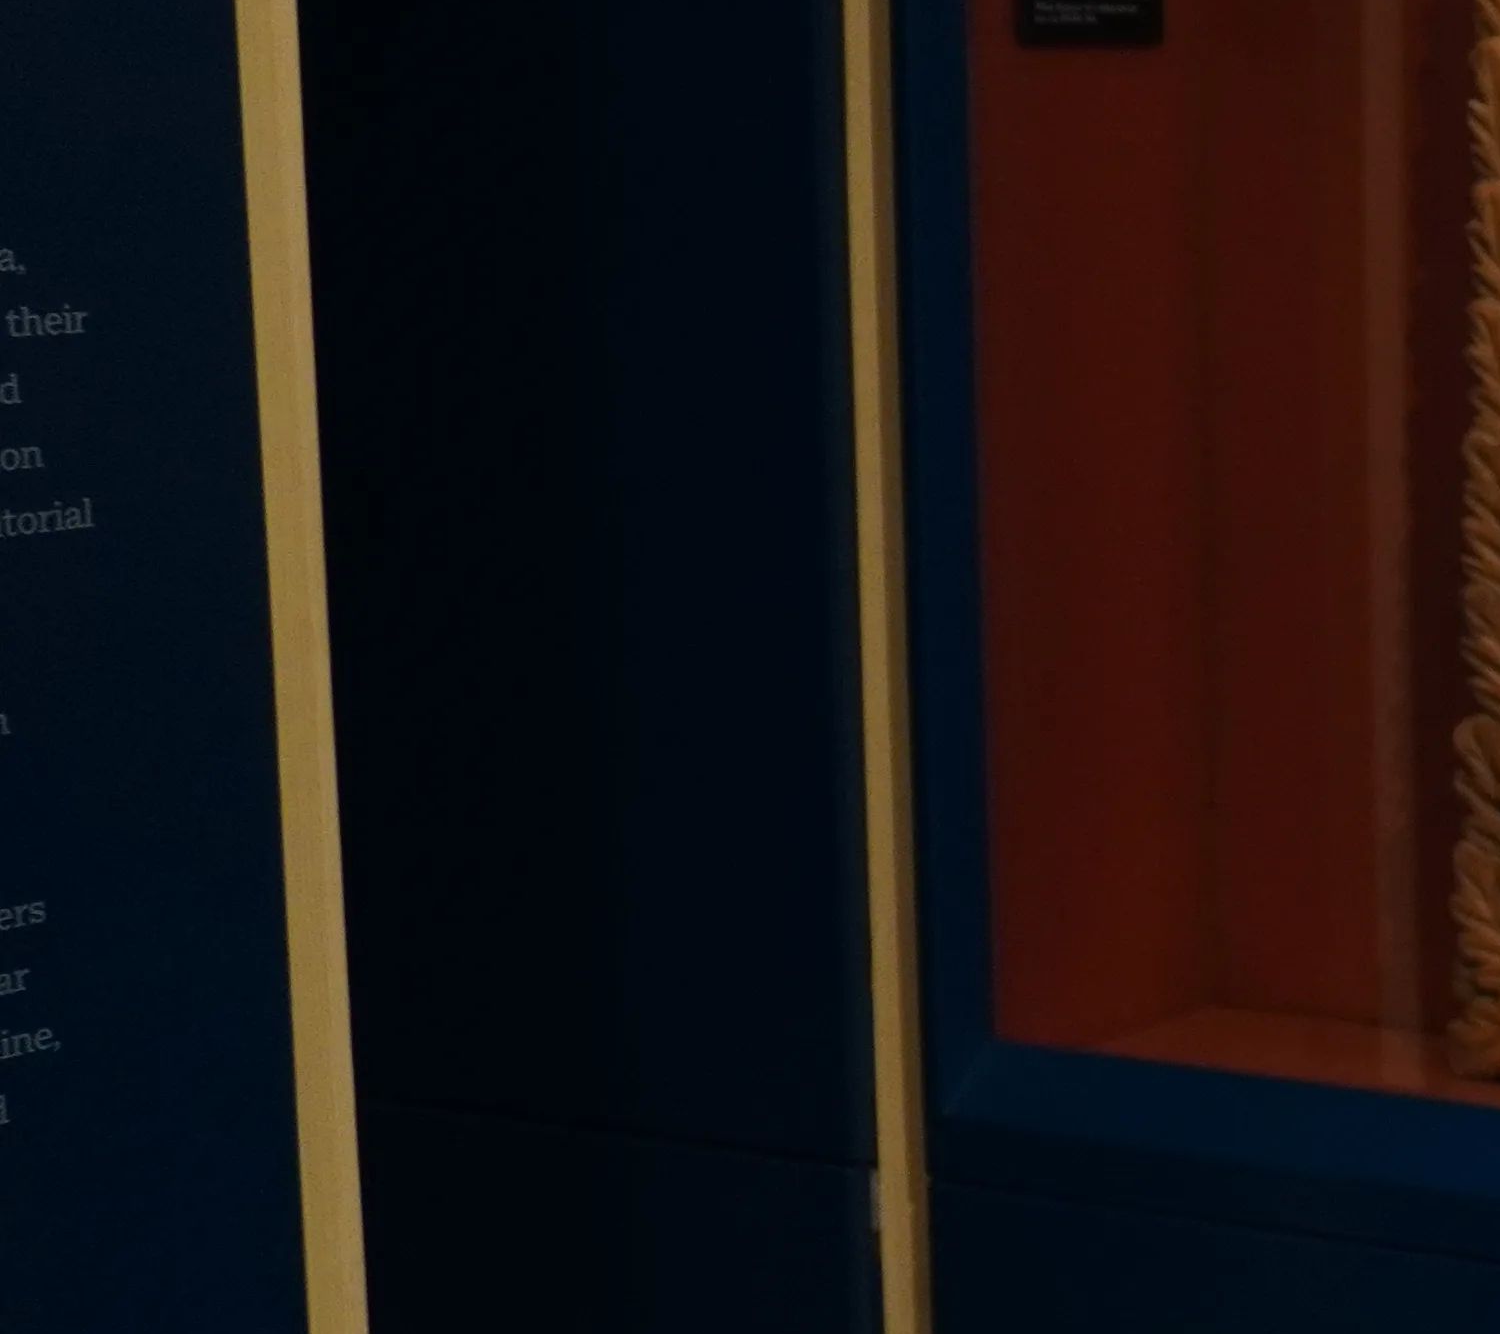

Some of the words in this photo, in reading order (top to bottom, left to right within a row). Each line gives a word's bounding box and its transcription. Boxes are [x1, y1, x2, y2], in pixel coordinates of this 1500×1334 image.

[5, 303, 89, 337] their
[0, 373, 23, 404] d
[0, 446, 44, 470] on
[0, 497, 95, 538] torial
[0, 901, 47, 930] ers
[0, 968, 30, 995] ar
[0, 1028, 61, 1058] ine,
